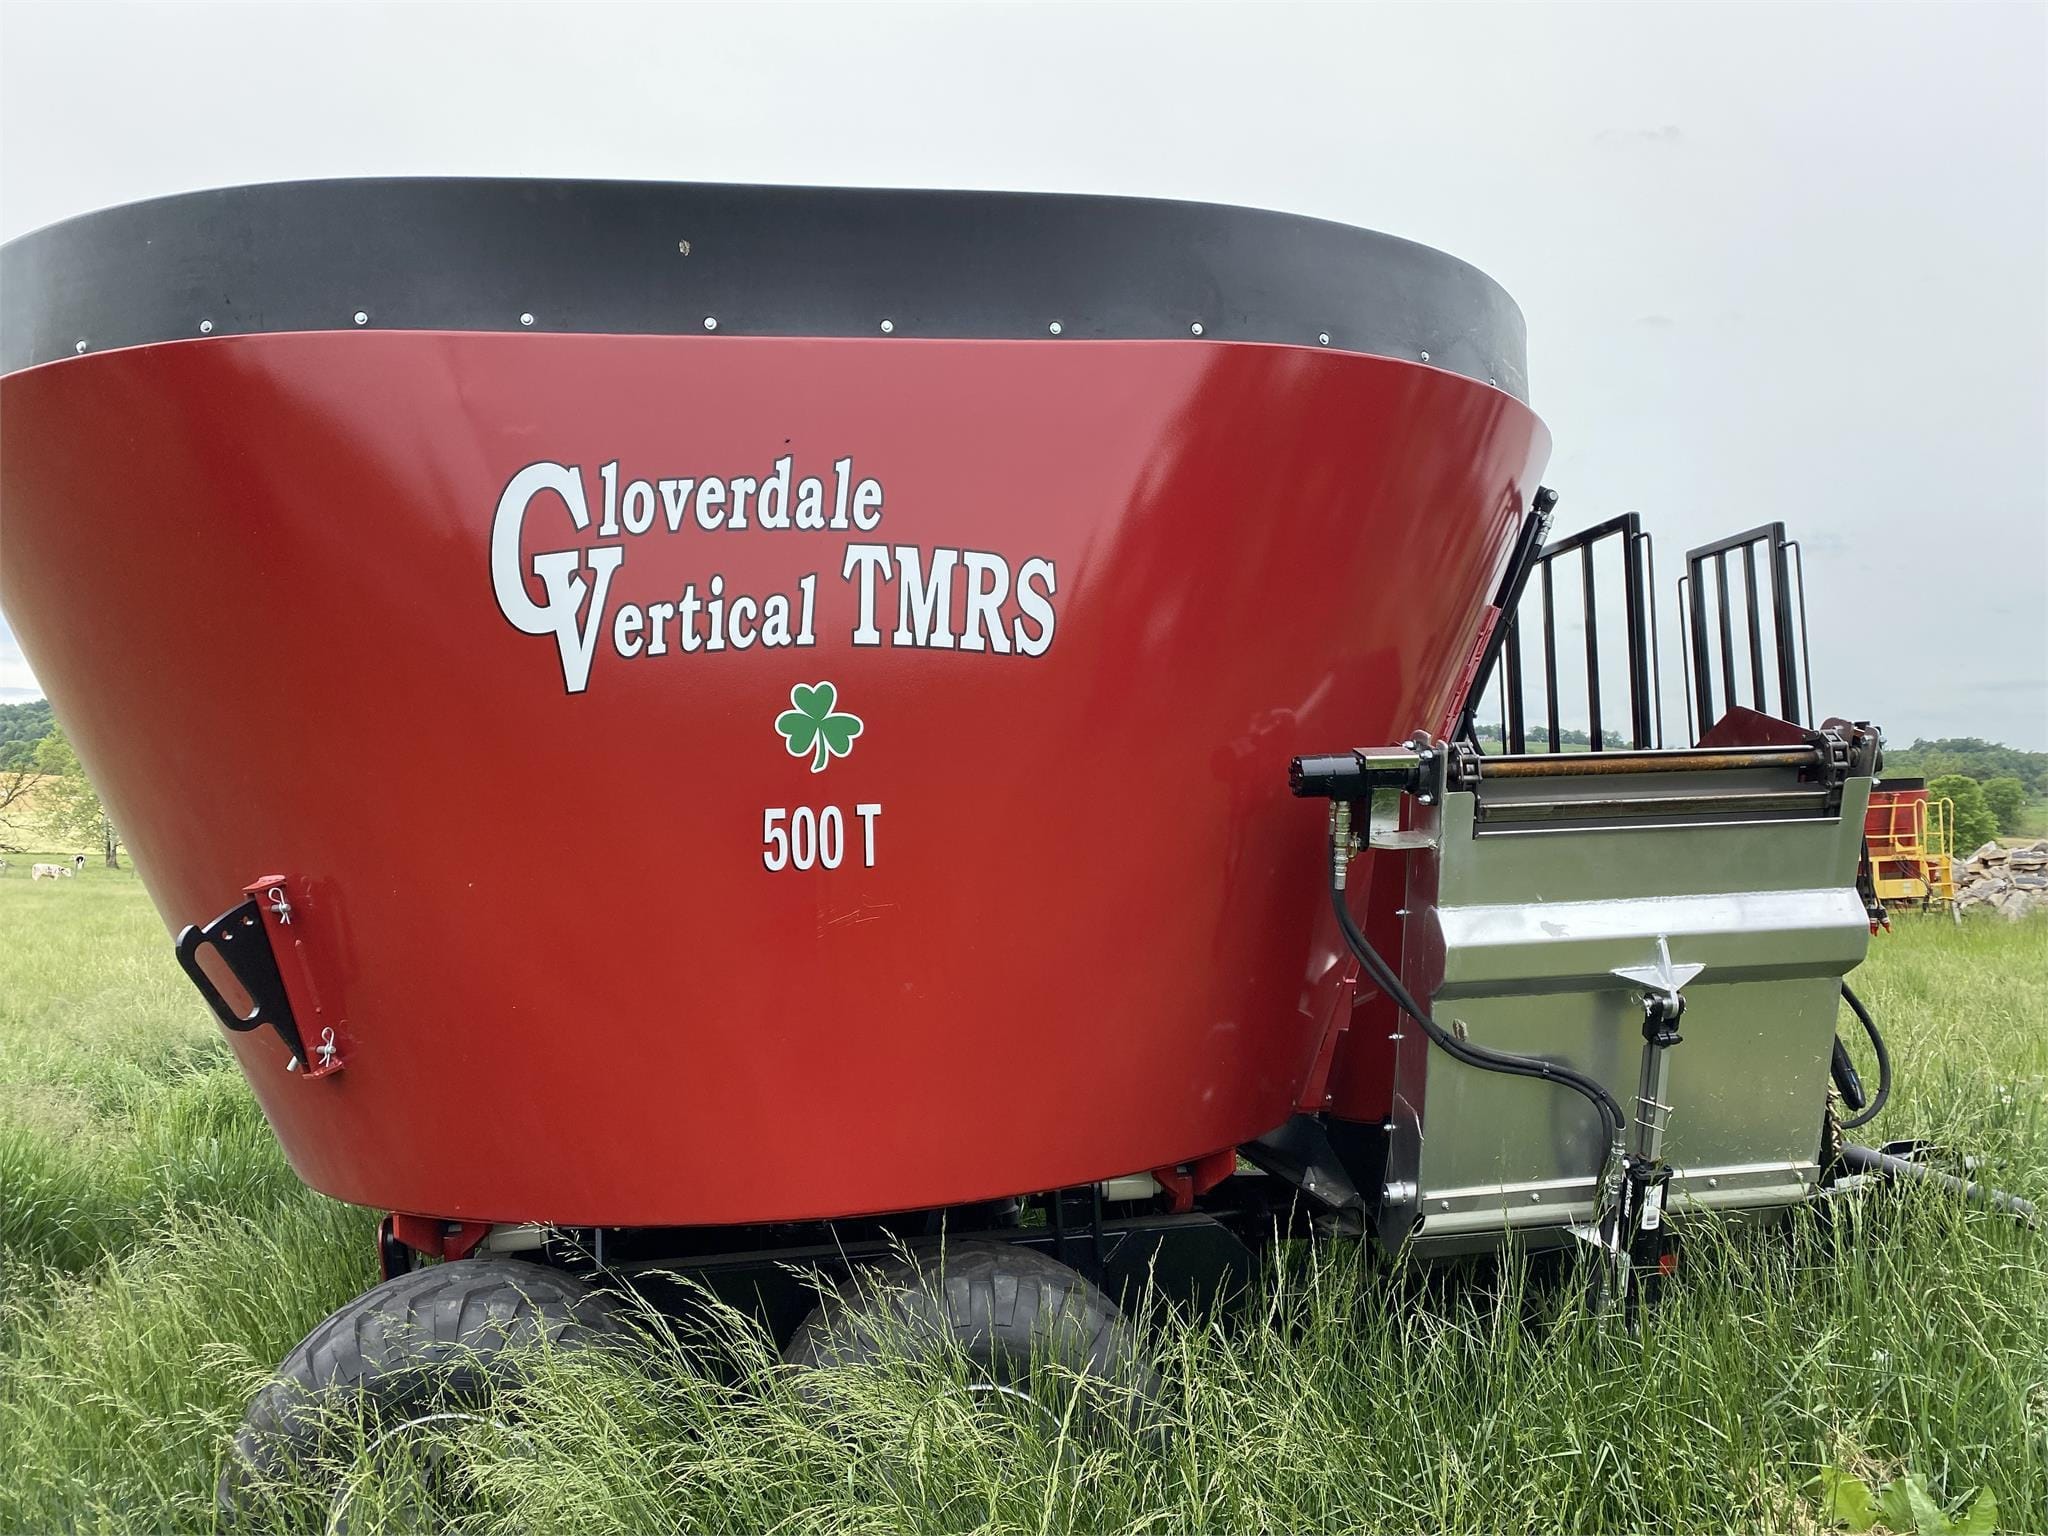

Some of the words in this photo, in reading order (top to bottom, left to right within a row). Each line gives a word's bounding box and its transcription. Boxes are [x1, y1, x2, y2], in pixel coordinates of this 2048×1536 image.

[532, 545, 819, 694] Vertical
[841, 542, 1059, 658] TMRS
[763, 804, 845, 872] 500
[855, 803, 882, 868] T
